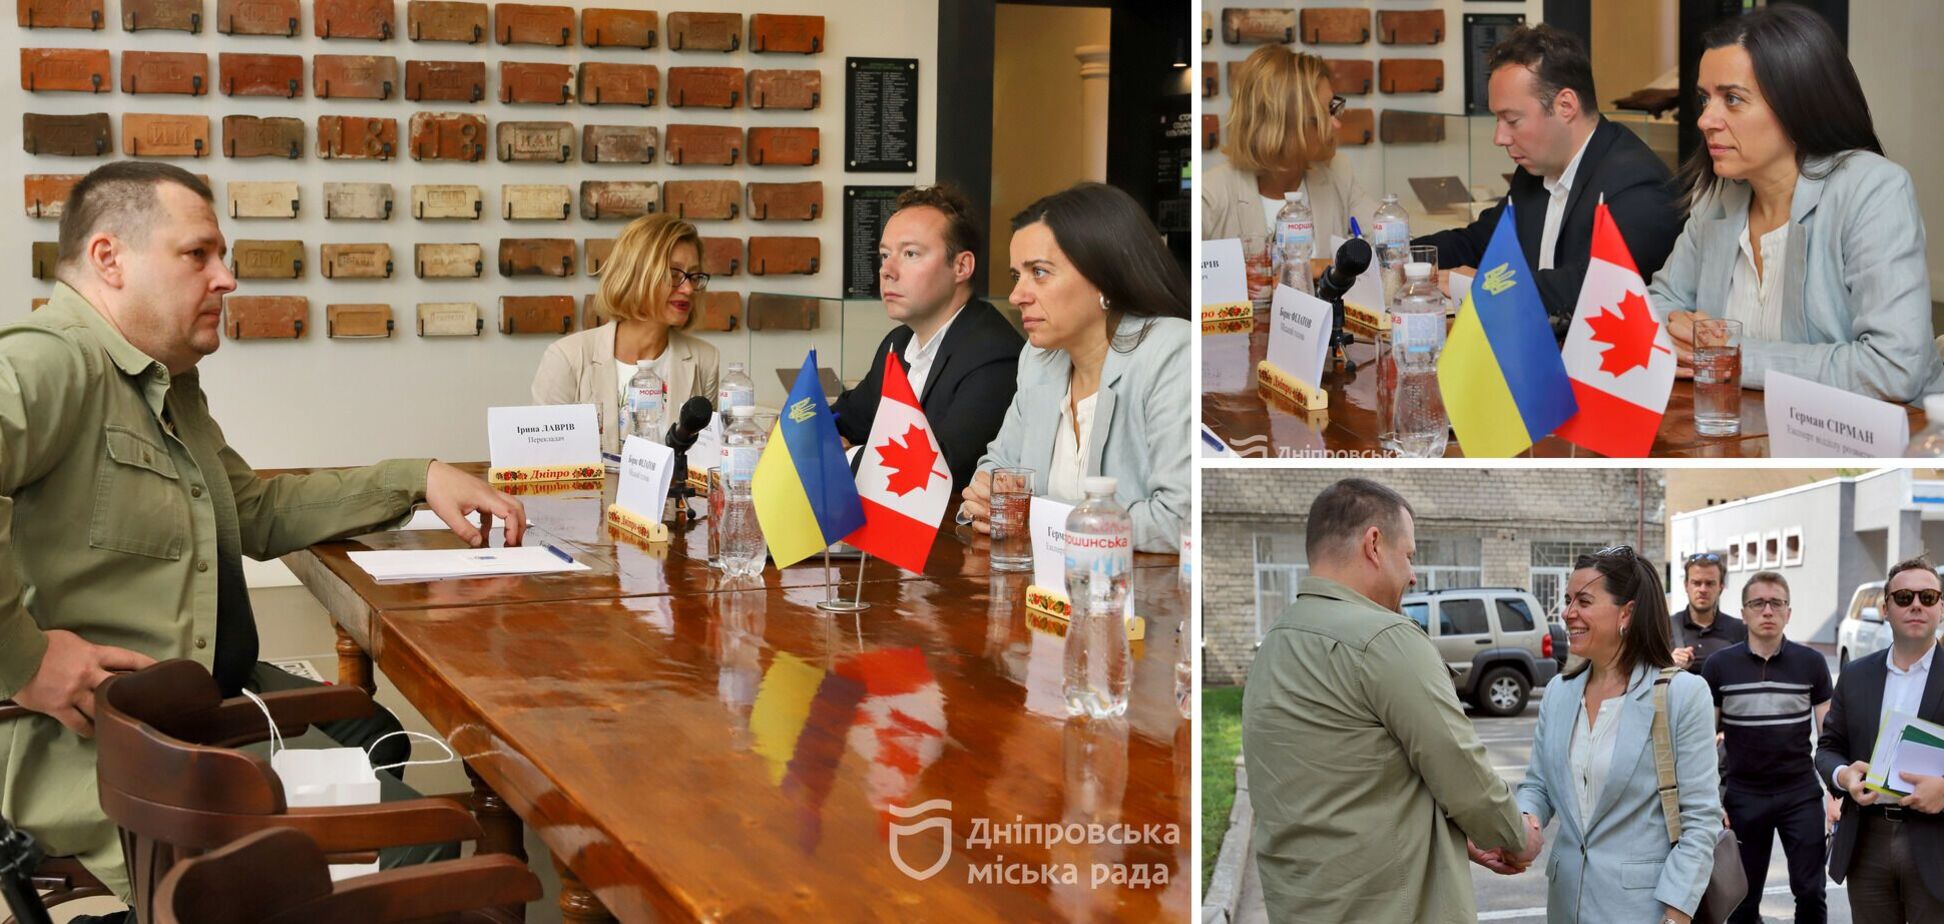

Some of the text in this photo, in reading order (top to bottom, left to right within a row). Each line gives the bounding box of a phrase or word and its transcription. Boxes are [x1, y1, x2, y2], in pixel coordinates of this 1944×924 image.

[517, 423, 575, 435] Ірина ЛАВРІВ
[1790, 406, 1874, 444] Герман СІРМАН
[530, 469, 570, 480] Дніпро
